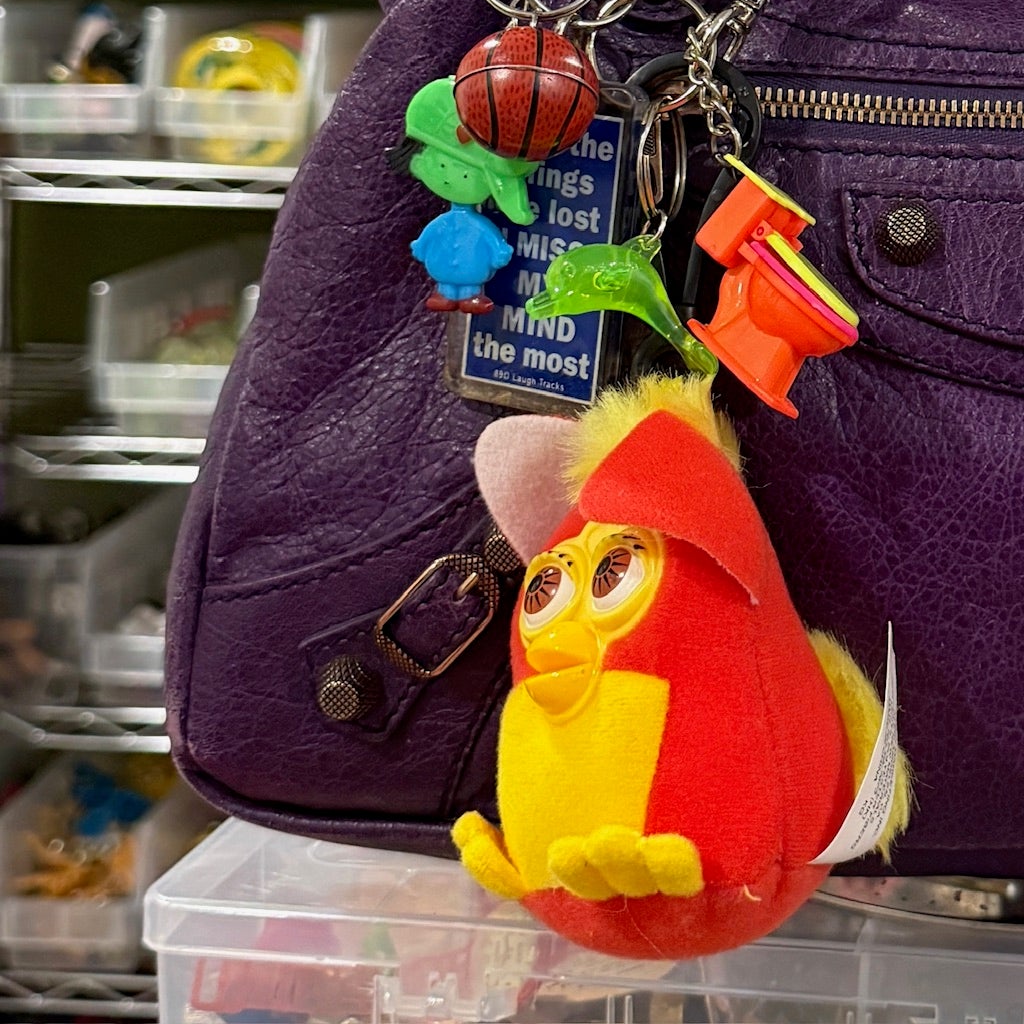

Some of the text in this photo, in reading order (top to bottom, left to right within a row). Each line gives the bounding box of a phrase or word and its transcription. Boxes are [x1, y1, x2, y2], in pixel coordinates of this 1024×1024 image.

[528, 160, 594, 198] ings
[549, 198, 600, 233] lost
[502, 305, 576, 343] MIND
[473, 331, 590, 380] the most
[512, 372, 537, 386] Laugh
[539, 377, 564, 392] Tracks
